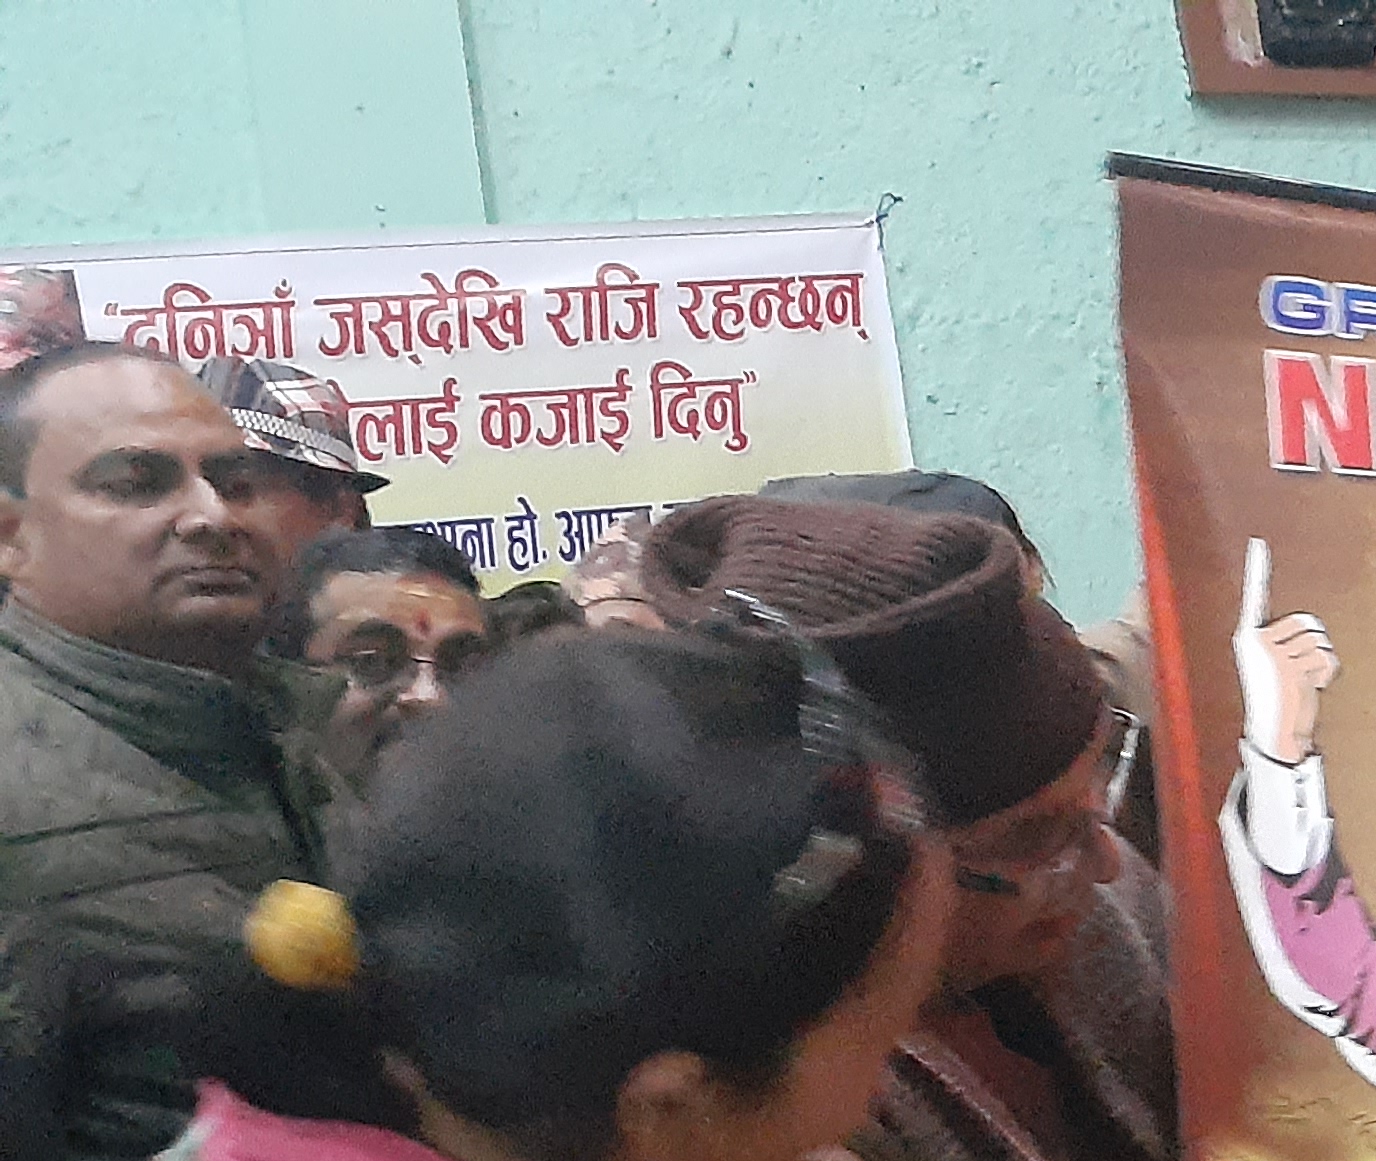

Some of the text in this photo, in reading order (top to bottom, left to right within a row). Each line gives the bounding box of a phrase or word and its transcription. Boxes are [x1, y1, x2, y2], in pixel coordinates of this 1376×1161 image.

[545, 263, 660, 347] राजि
[677, 273, 869, 341] रहन्छन्
[479, 368, 633, 453] कजाई
